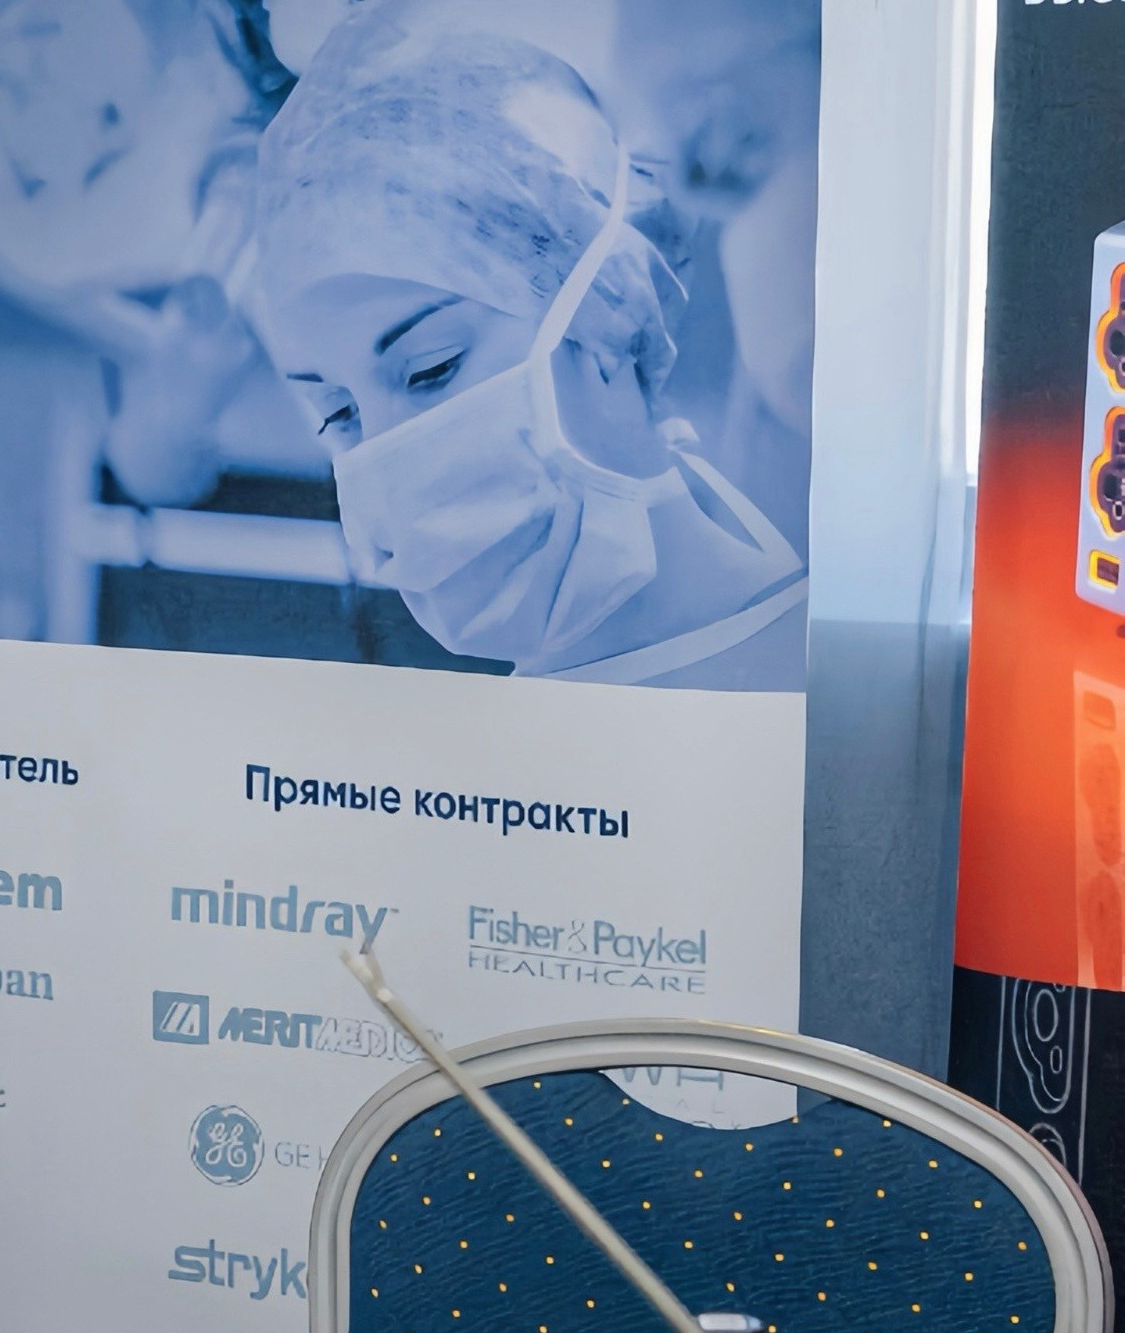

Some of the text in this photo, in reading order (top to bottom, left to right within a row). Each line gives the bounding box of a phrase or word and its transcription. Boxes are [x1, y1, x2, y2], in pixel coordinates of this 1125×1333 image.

[246, 763, 629, 839] Прямые контракты
[171, 879, 388, 955] mindray
[469, 904, 565, 951] Fisher
[593, 920, 707, 967] Paykel
[468, 951, 706, 995] HEALTHCARE
